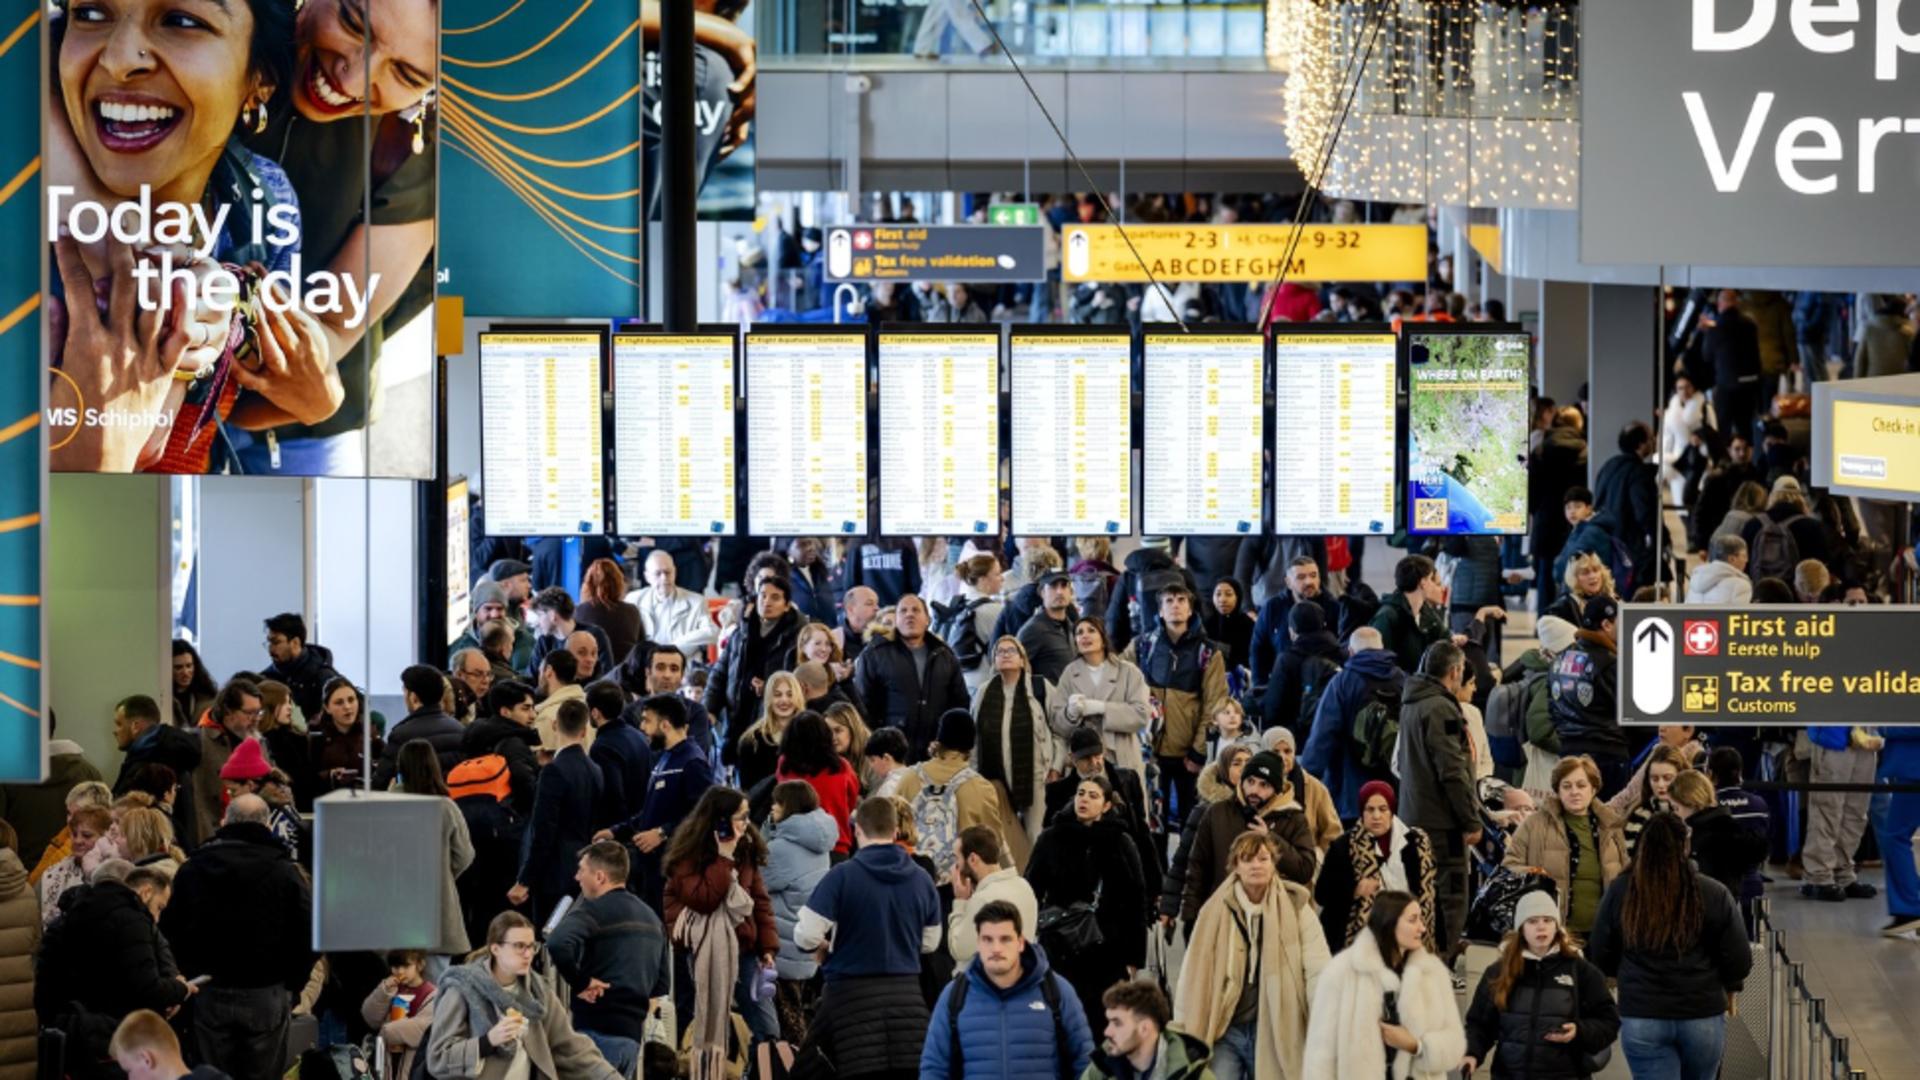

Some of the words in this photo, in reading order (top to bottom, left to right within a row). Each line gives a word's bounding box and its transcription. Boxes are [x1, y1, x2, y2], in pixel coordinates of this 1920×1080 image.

[1692, 0, 1920, 80] Dep
[47, 184, 231, 258] Today
[251, 187, 300, 246] is
[1185, 231, 1218, 248] 2-3
[1313, 231, 1361, 248] 9-32
[874, 255, 897, 267] Tax
[900, 254, 926, 267] free
[929, 254, 996, 267] validation
[132, 252, 240, 311] the
[260, 253, 382, 329] day
[1417, 369, 1457, 380] WHERE
[1461, 369, 1478, 380] ON
[1480, 369, 1523, 380] EARTH?
[84, 408, 173, 431] Schiphol
[1727, 614, 1785, 637] First
[1794, 614, 1836, 637] aid
[1727, 643, 1781, 657] Eerste
[1783, 642, 1820, 659] hulp
[1726, 671, 1771, 693] Tax
[1779, 671, 1833, 693] free
[1842, 671, 1920, 693] valida
[1727, 697, 1796, 713] Customs
